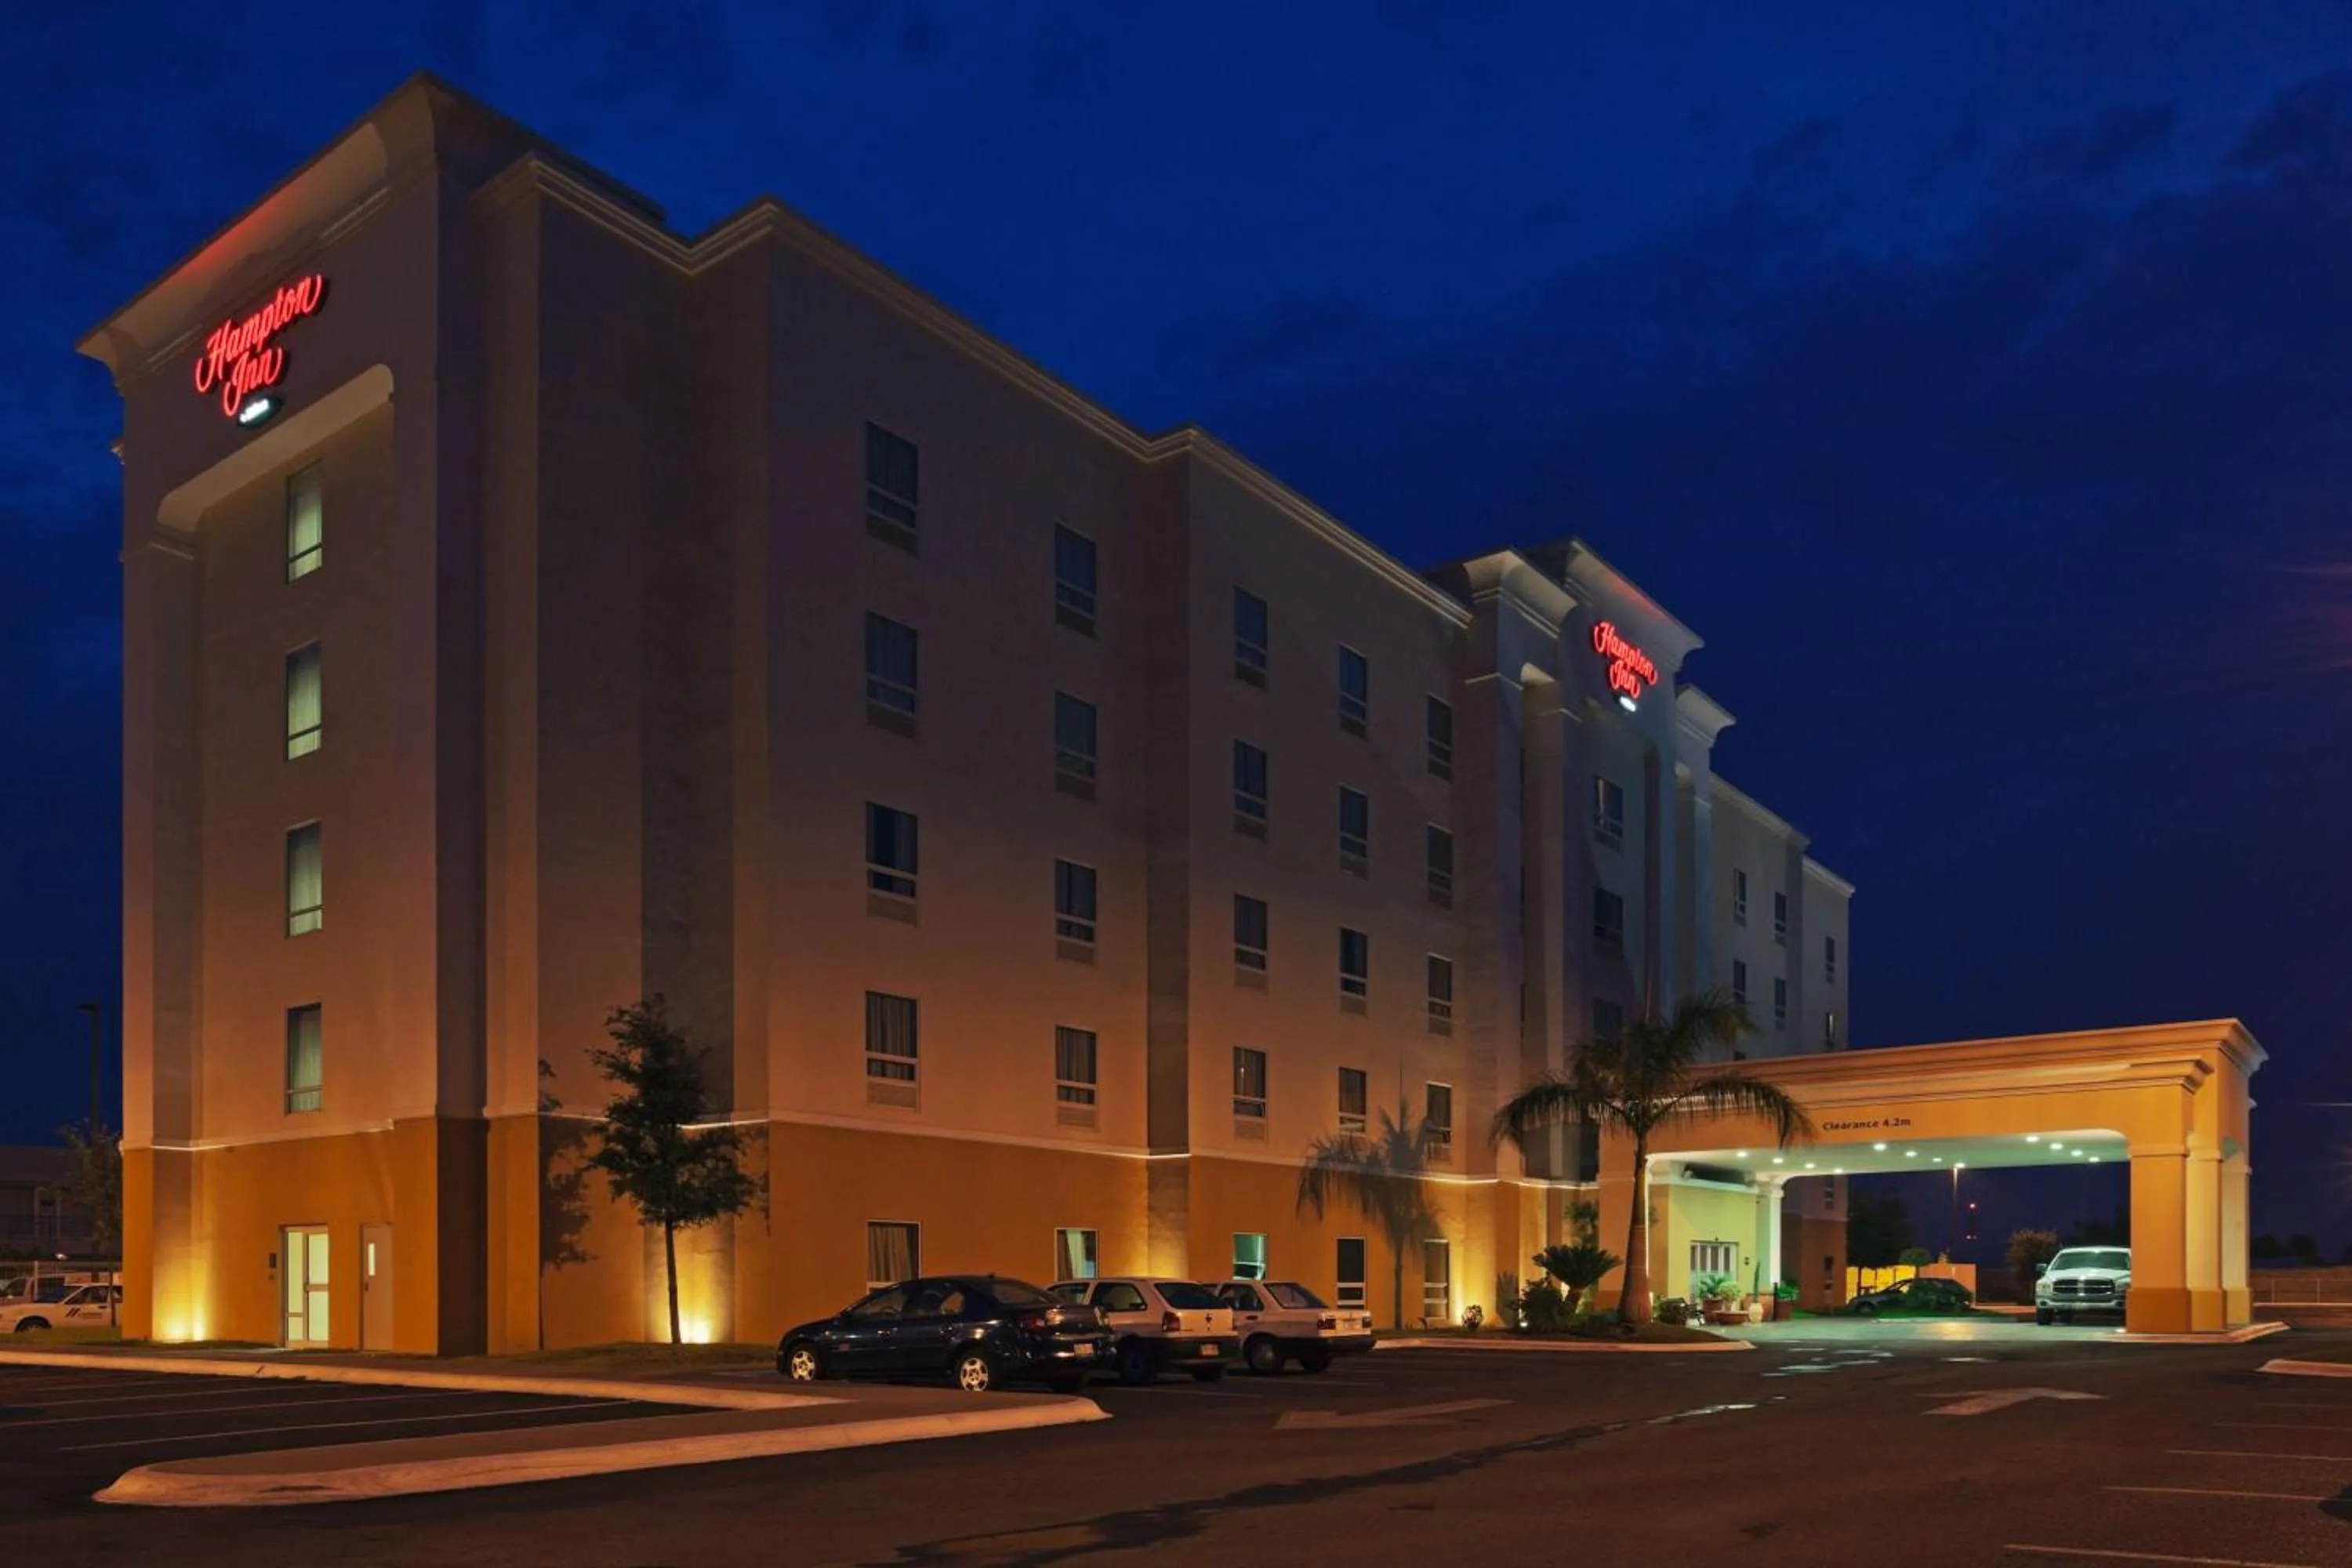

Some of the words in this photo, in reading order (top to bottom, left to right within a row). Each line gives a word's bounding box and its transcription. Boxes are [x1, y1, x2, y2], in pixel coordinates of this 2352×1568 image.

[196, 274, 322, 393] Hampton
[223, 347, 283, 417] Inn
[1594, 622, 1658, 686] Hampton
[1610, 660, 1641, 699] Inn
[1823, 1120, 1879, 1131] Clearance
